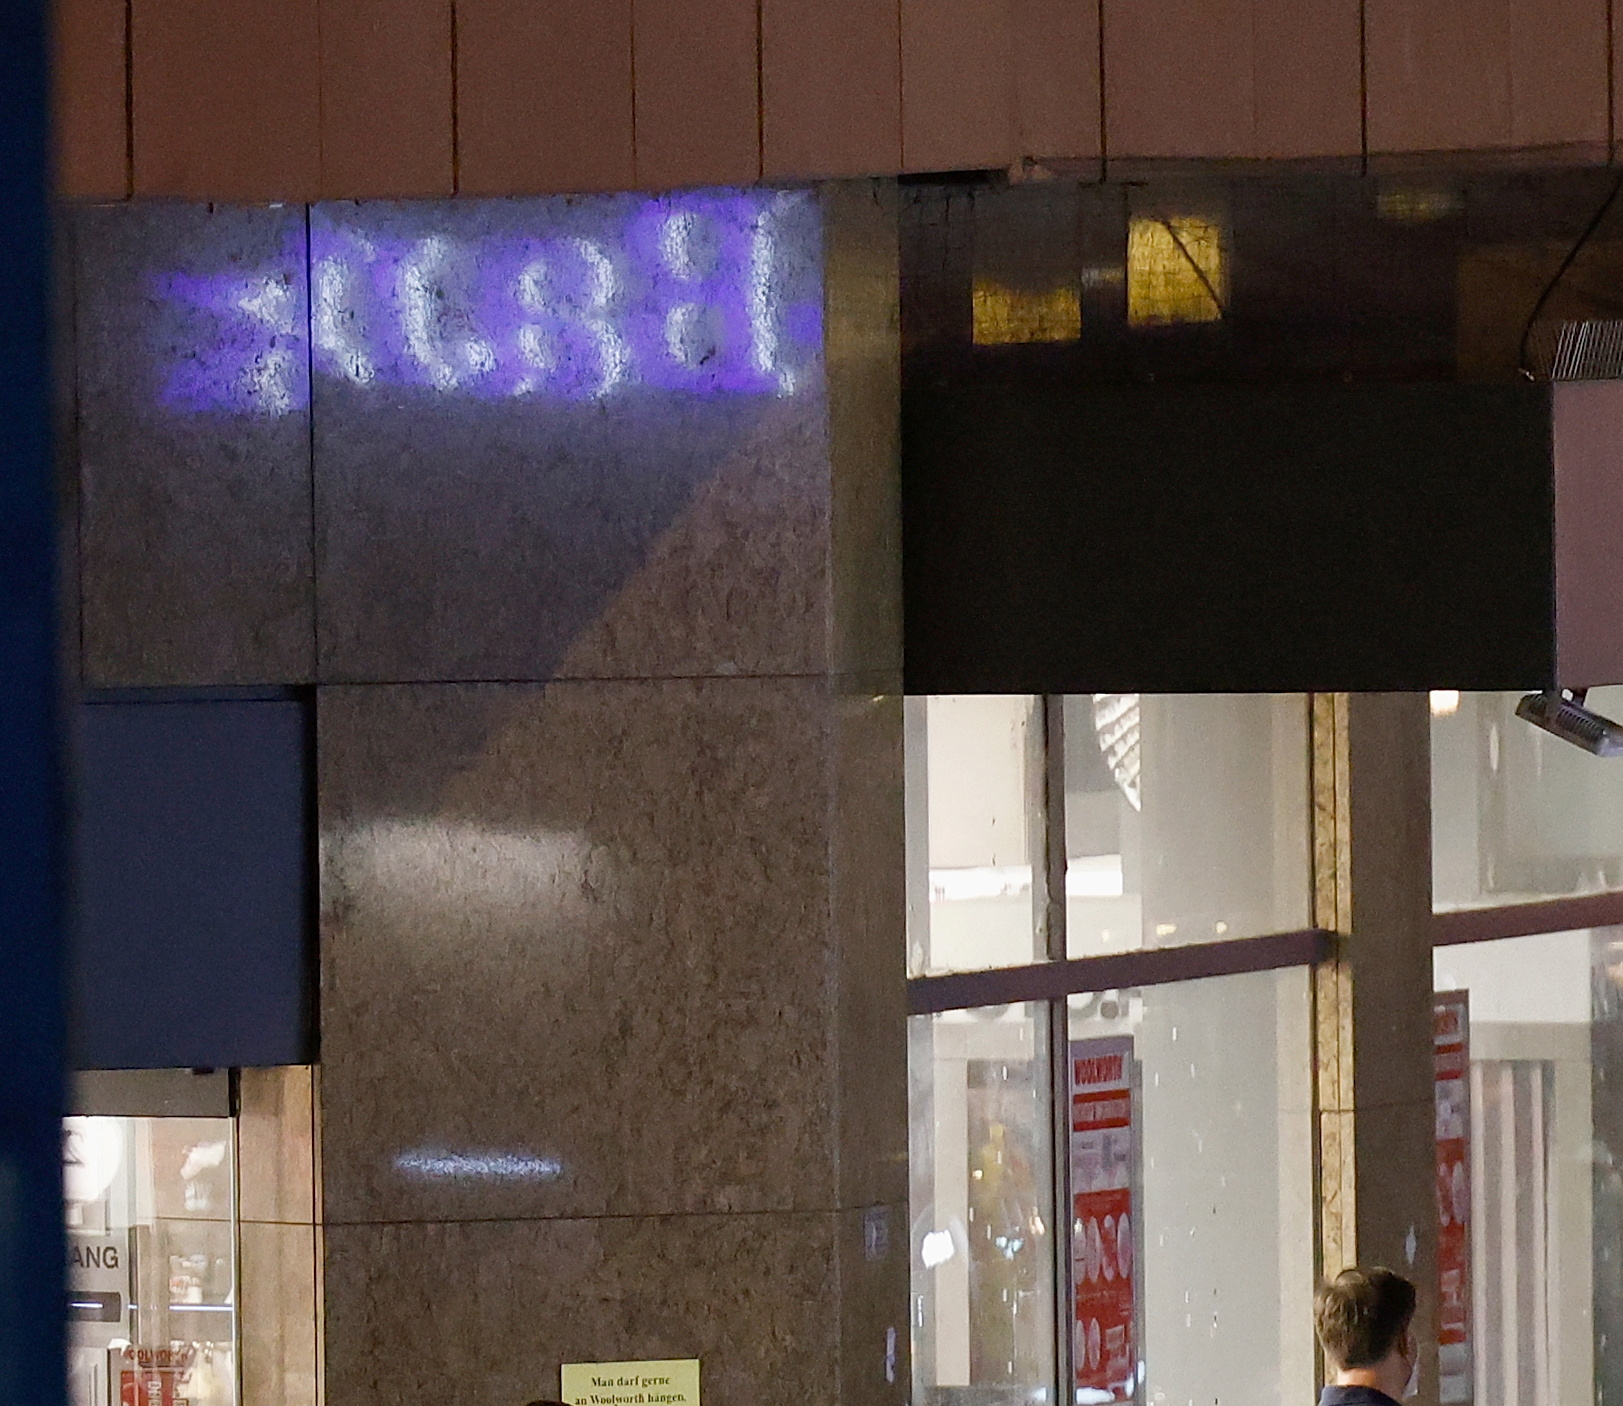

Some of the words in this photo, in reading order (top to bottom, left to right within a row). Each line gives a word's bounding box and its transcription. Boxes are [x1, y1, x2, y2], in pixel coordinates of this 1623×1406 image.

[71, 1245, 119, 1269] ANG
[591, 1376, 614, 1387] Man
[616, 1375, 640, 1387] darf
[641, 1376, 671, 1388] gerne
[575, 1397, 588, 1406] an
[590, 1393, 645, 1406] Woolworth
